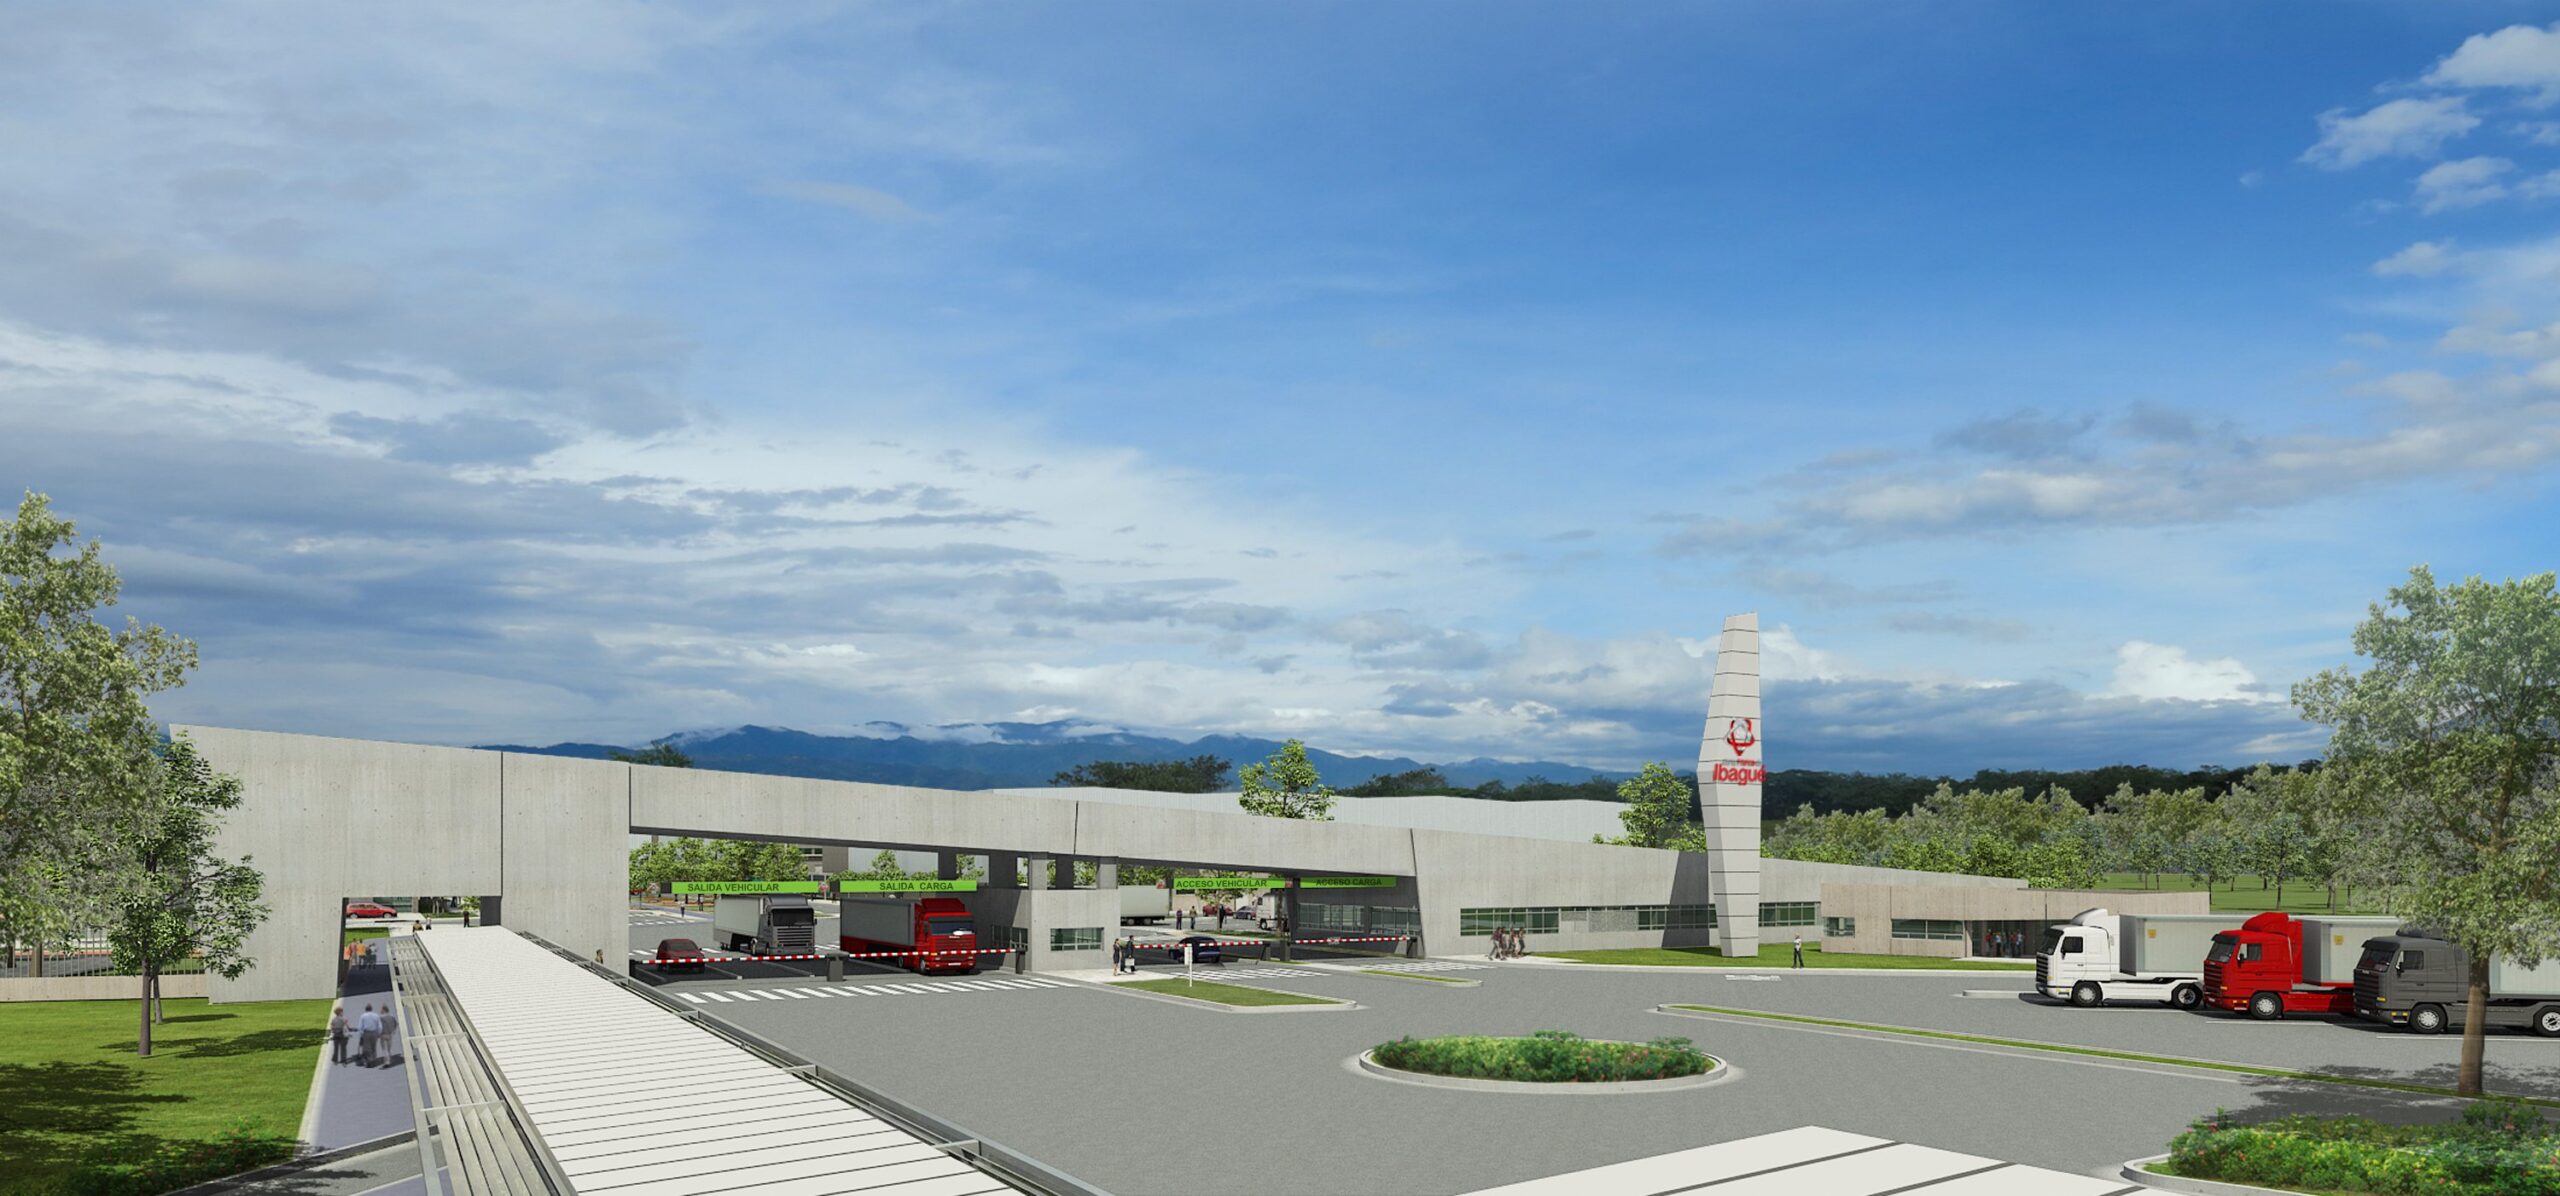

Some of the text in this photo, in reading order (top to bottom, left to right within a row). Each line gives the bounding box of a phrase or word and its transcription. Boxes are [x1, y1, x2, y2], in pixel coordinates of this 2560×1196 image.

[1713, 763, 1767, 785] Ibagué
[879, 882, 954, 891] SALIDA CARGA
[1176, 880, 1214, 888] ACCESO
[1316, 878, 1383, 886] ACCESO CARGA
[687, 883, 779, 892] SALIDA VEHICULAR
